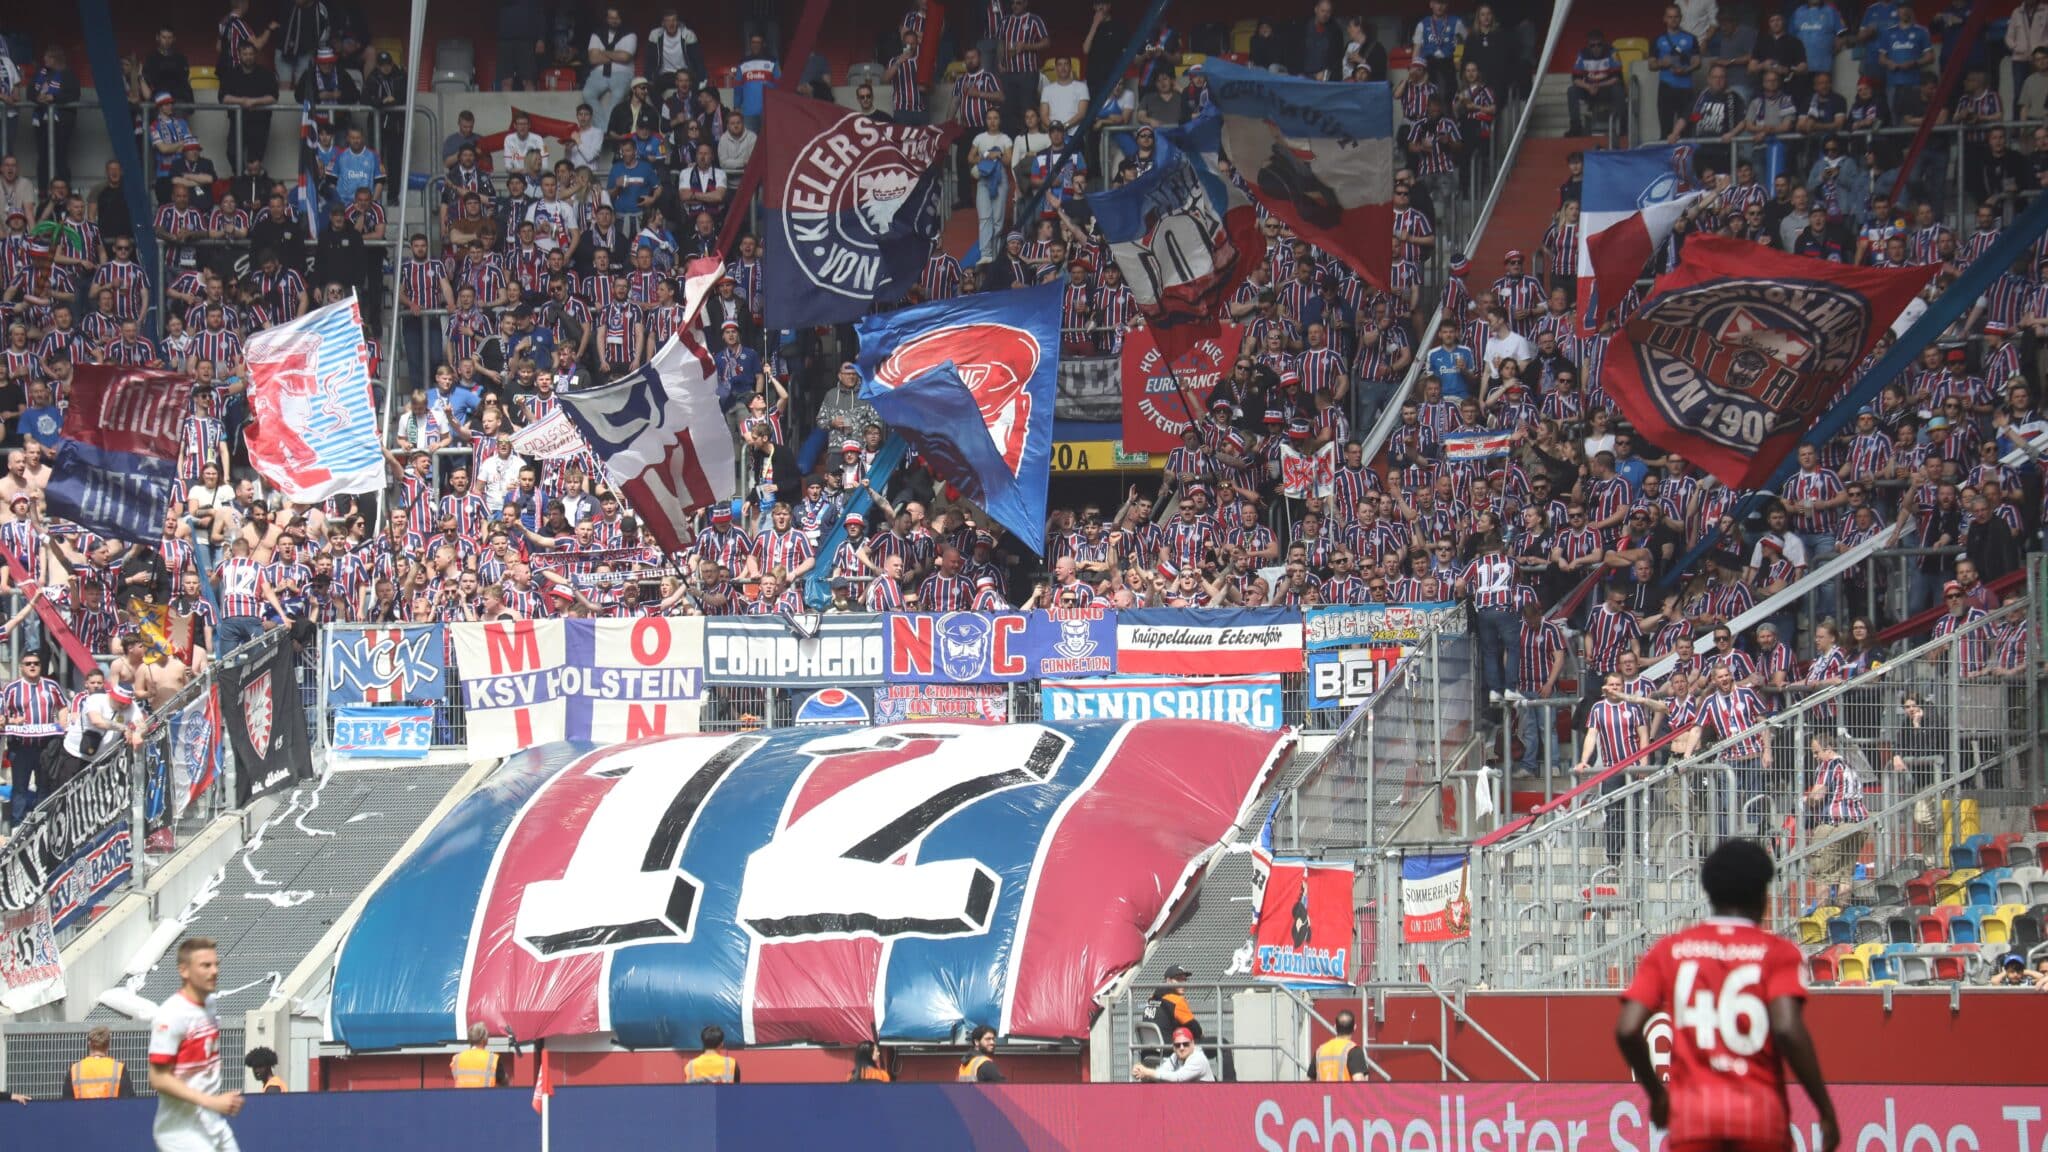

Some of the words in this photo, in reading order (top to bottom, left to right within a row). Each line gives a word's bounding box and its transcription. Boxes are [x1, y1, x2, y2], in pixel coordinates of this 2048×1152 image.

[791, 133, 862, 241] KIELER
[817, 243, 880, 291] VON
[1652, 350, 1707, 412] ON
[224, 565, 256, 596] 12
[1477, 562, 1512, 593] 12
[707, 634, 884, 677] COMPAGNO
[1131, 627, 1214, 649] Knüppelduun
[1218, 625, 1283, 646] Eckernföör
[330, 632, 439, 693] NCK
[1041, 657, 1111, 673] CONNECTION
[468, 674, 537, 709] KSV
[546, 666, 695, 701] HOLSTEIN
[910, 700, 928, 714] ON
[937, 700, 977, 714] TOUR
[1053, 688, 1274, 728] RENDSBURG
[336, 720, 387, 746] SEK
[400, 720, 430, 746] FS
[91, 839, 131, 884] BANDE
[513, 722, 1074, 962] 12
[1405, 879, 1460, 902] SOMMERHAUS
[1410, 919, 1421, 932] ON
[1422, 917, 1442, 931] TOUR
[1673, 960, 1770, 1056] 46
[1254, 1095, 1588, 1152] Schnellster
[1856, 1097, 1980, 1152] des
